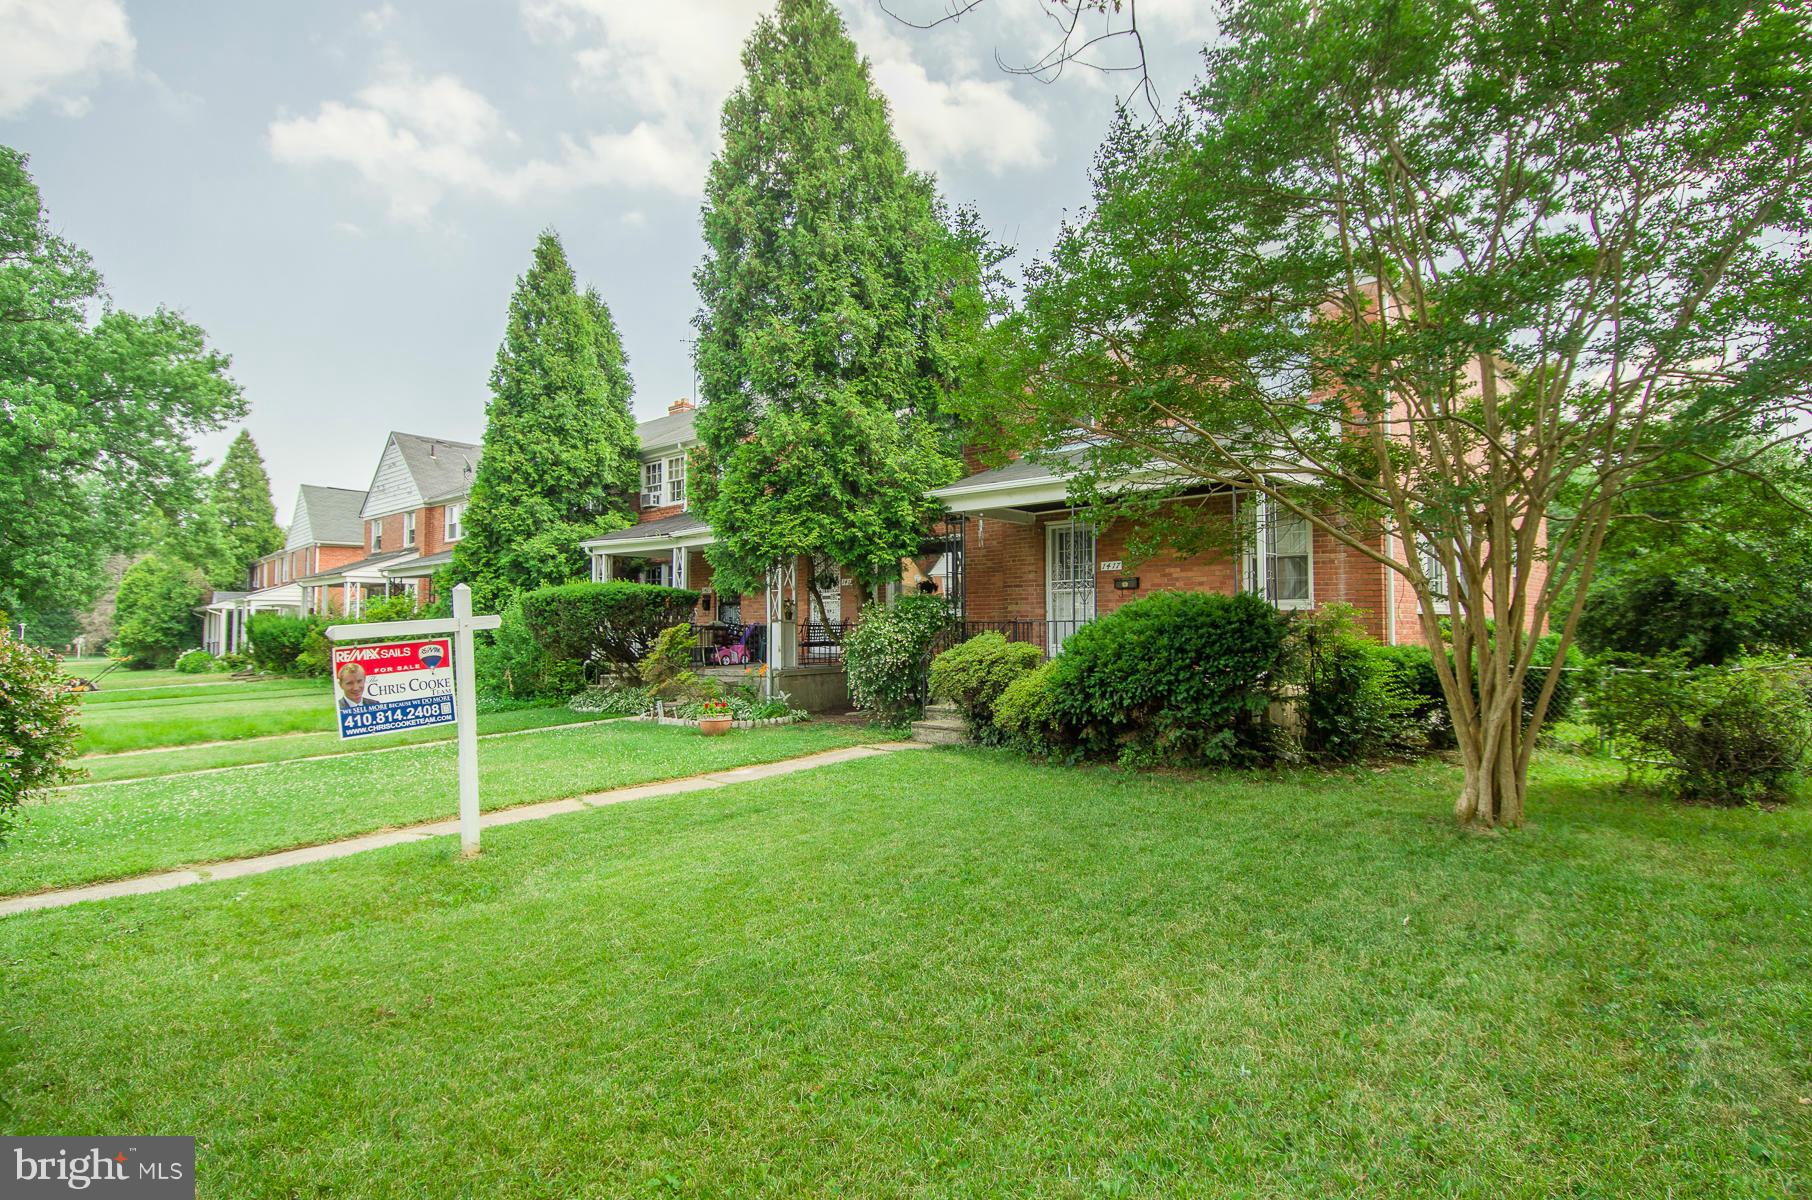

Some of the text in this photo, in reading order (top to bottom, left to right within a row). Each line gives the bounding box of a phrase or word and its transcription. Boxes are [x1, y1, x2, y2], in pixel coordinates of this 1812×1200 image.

[336, 647, 411, 663] RE/MAX SAILS
[421, 646, 441, 655] RE/MAX
[367, 677, 451, 697] CHRIS COOKE
[352, 706, 368, 714] SELL
[368, 703, 388, 712] MORE
[388, 700, 411, 709] BECAUSE
[421, 697, 432, 705] DO
[432, 695, 451, 703] MORE
[344, 705, 440, 728] 410.814.2408
